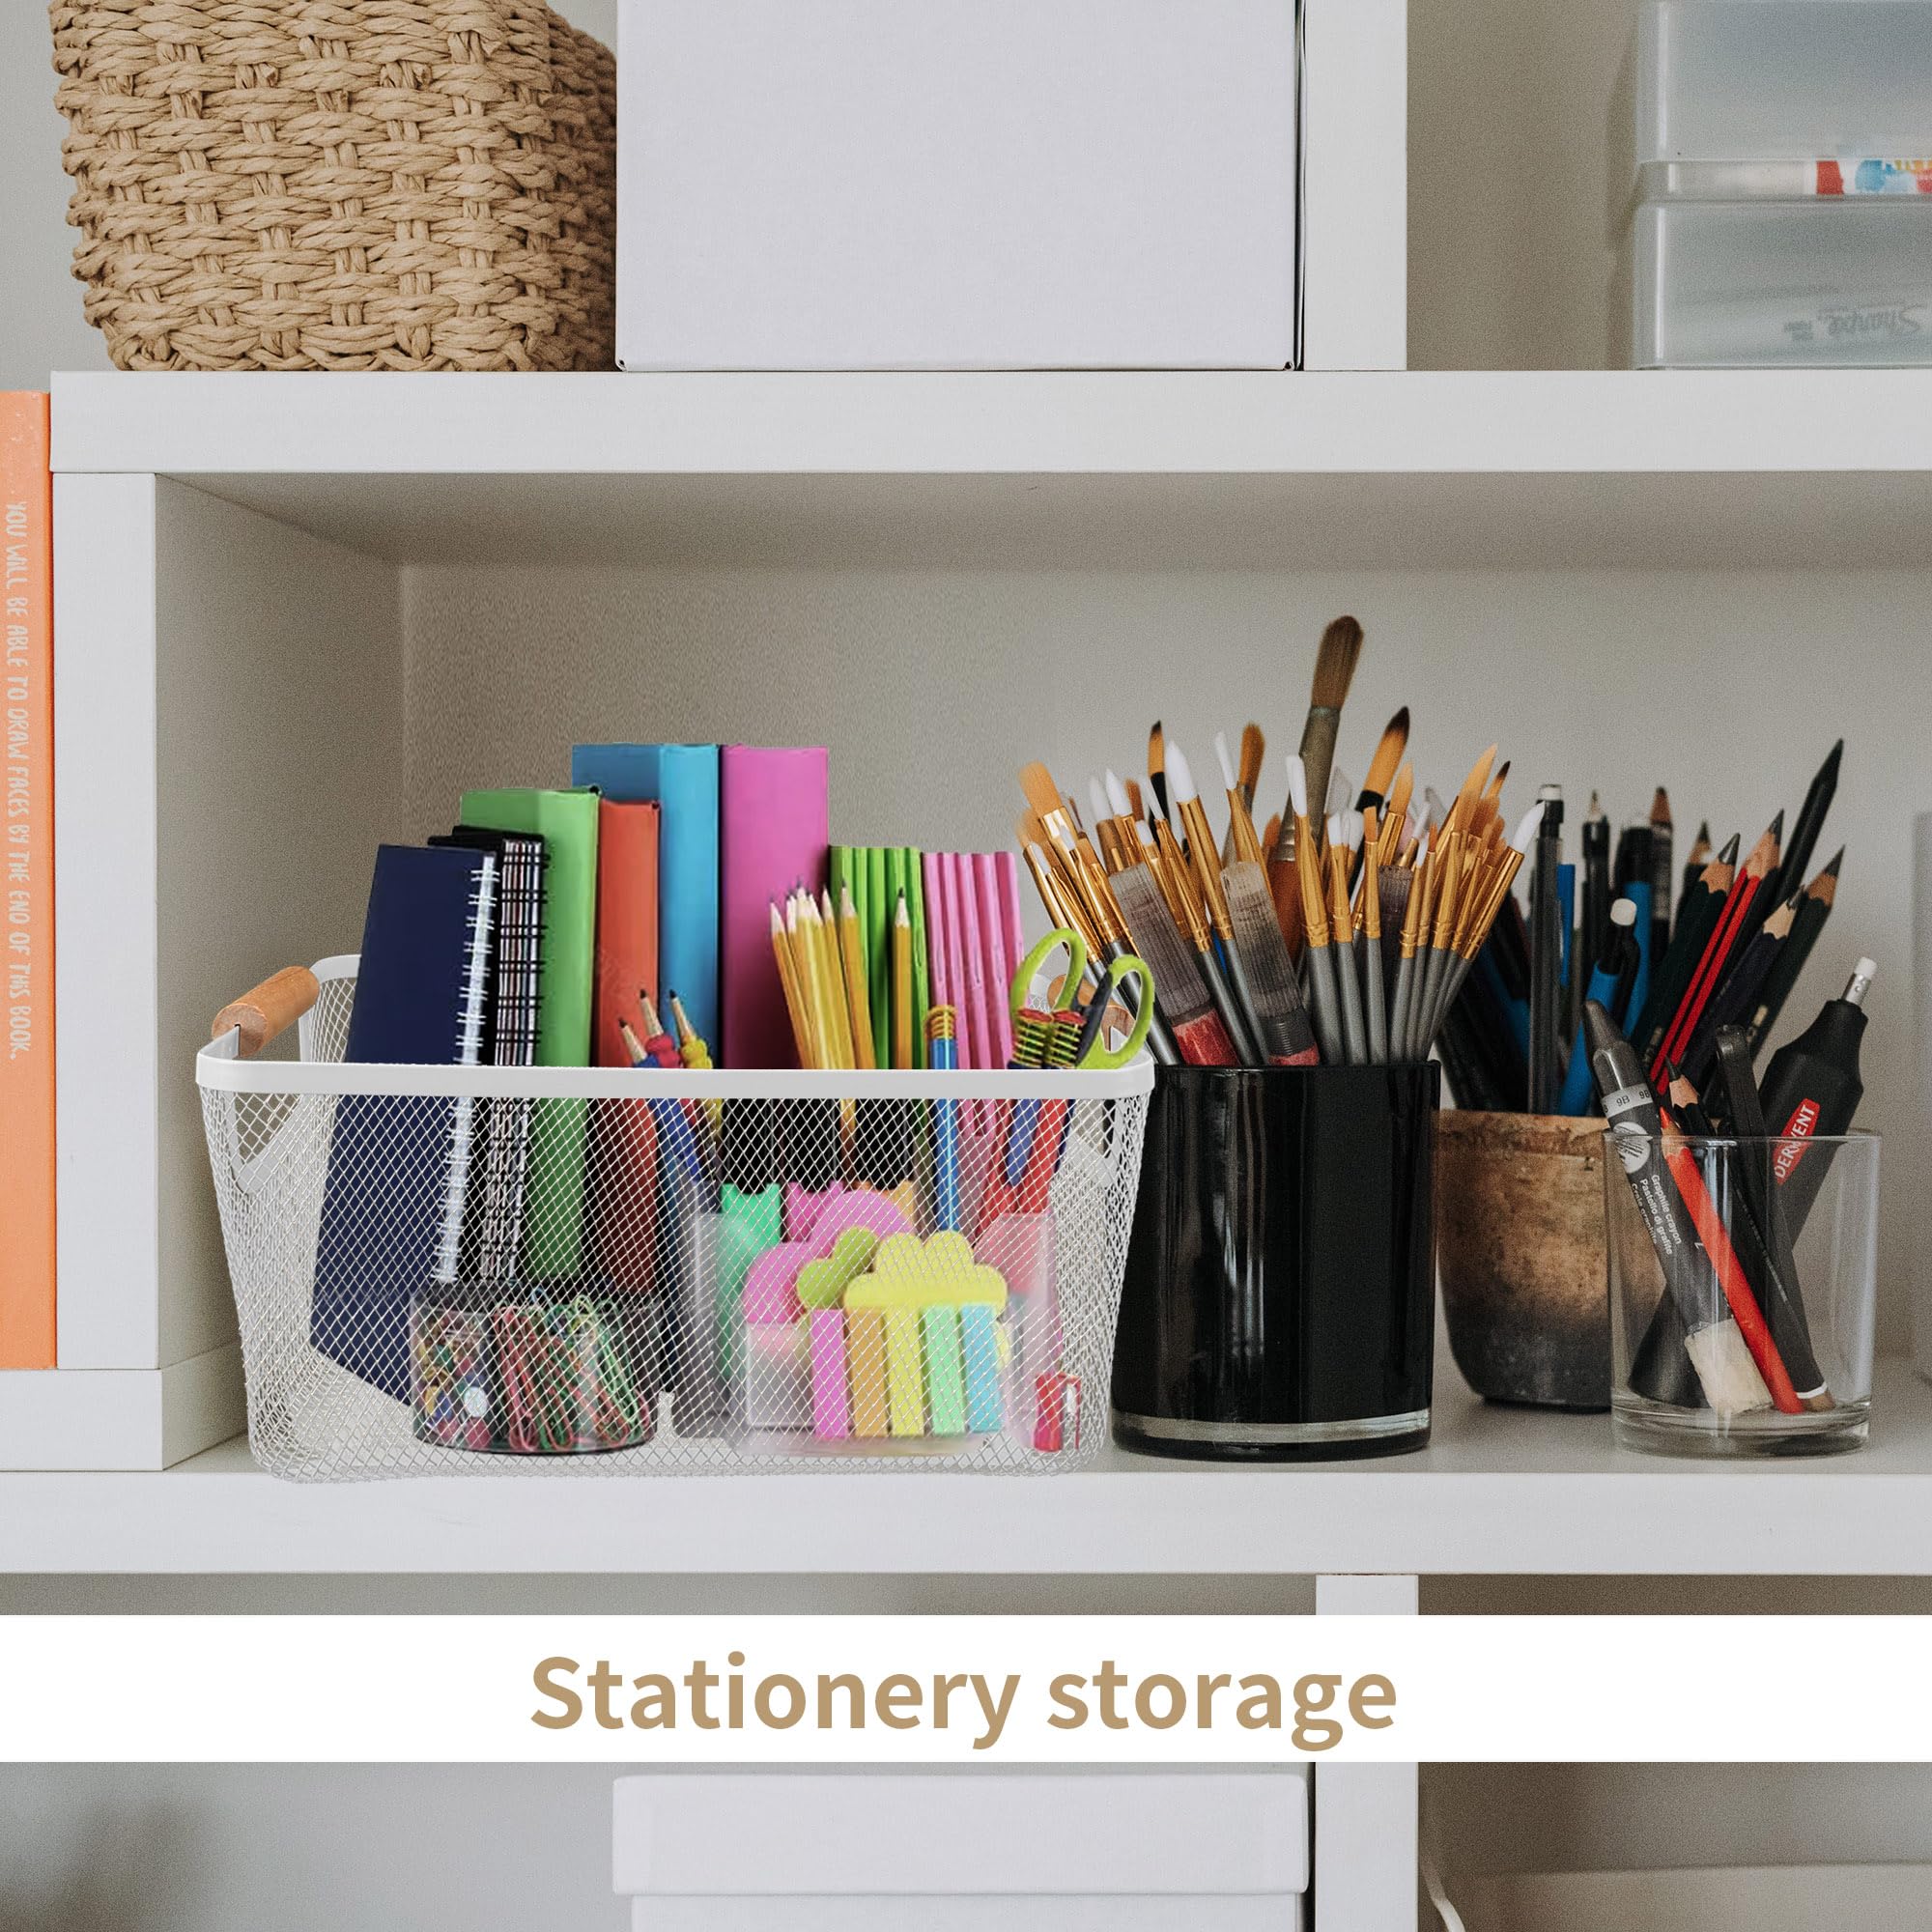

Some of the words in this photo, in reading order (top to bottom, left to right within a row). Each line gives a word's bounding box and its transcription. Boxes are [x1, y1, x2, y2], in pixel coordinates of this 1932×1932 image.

[6, 501, 27, 537] YOU
[7, 597, 28, 615] BE
[8, 624, 28, 667] ABLE
[7, 676, 28, 700] TO
[8, 708, 29, 759] DRAW
[8, 766, 30, 817] FACES
[9, 824, 29, 843] BY
[9, 851, 30, 881] THE
[9, 890, 30, 924] END
[10, 931, 30, 955] OF
[10, 1006, 31, 1060] BOOK.
[1616, 1094, 1631, 1107] 9B
[1640, 1178, 1658, 1214] Pastello
[1651, 1174, 1670, 1213] Graphite
[1664, 1212, 1683, 1245] crayon
[1653, 1213, 1663, 1226] di
[1656, 1224, 1673, 1256] grafite
